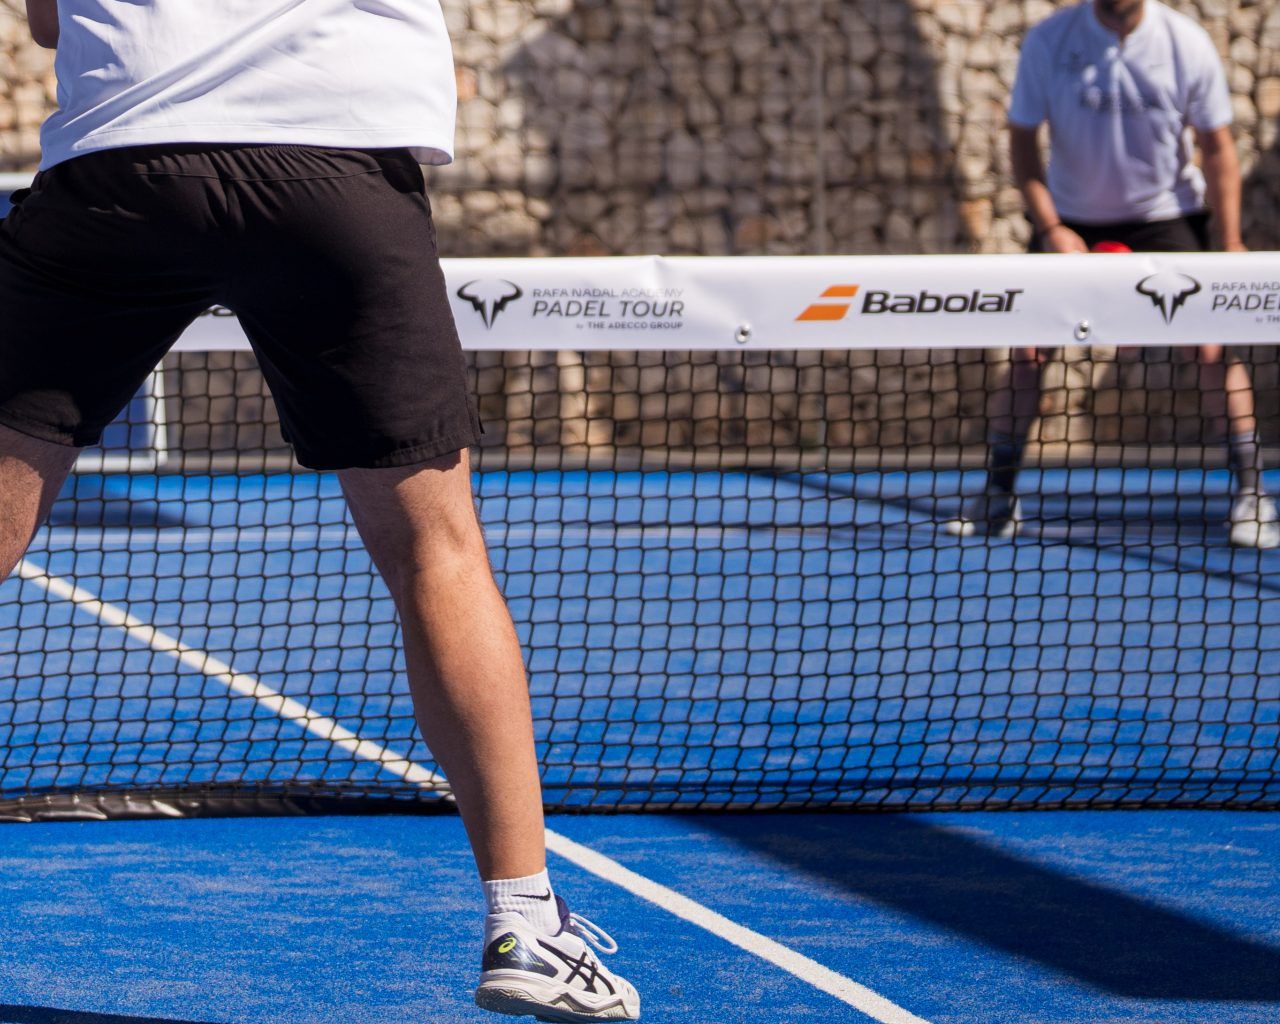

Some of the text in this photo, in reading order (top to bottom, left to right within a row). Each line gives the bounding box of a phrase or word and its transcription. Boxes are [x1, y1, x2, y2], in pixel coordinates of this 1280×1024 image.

[1211, 281, 1280, 291] RAFA NAD
[532, 288, 568, 297] RAFA
[572, 288, 618, 297] NADAL
[1211, 293, 1280, 311] PADE
[532, 300, 685, 317] PADEL TOUR
[1267, 315, 1280, 323] TH
[588, 321, 605, 329] THE
[608, 321, 647, 329] ADECCO
[650, 321, 683, 329] GROUP
